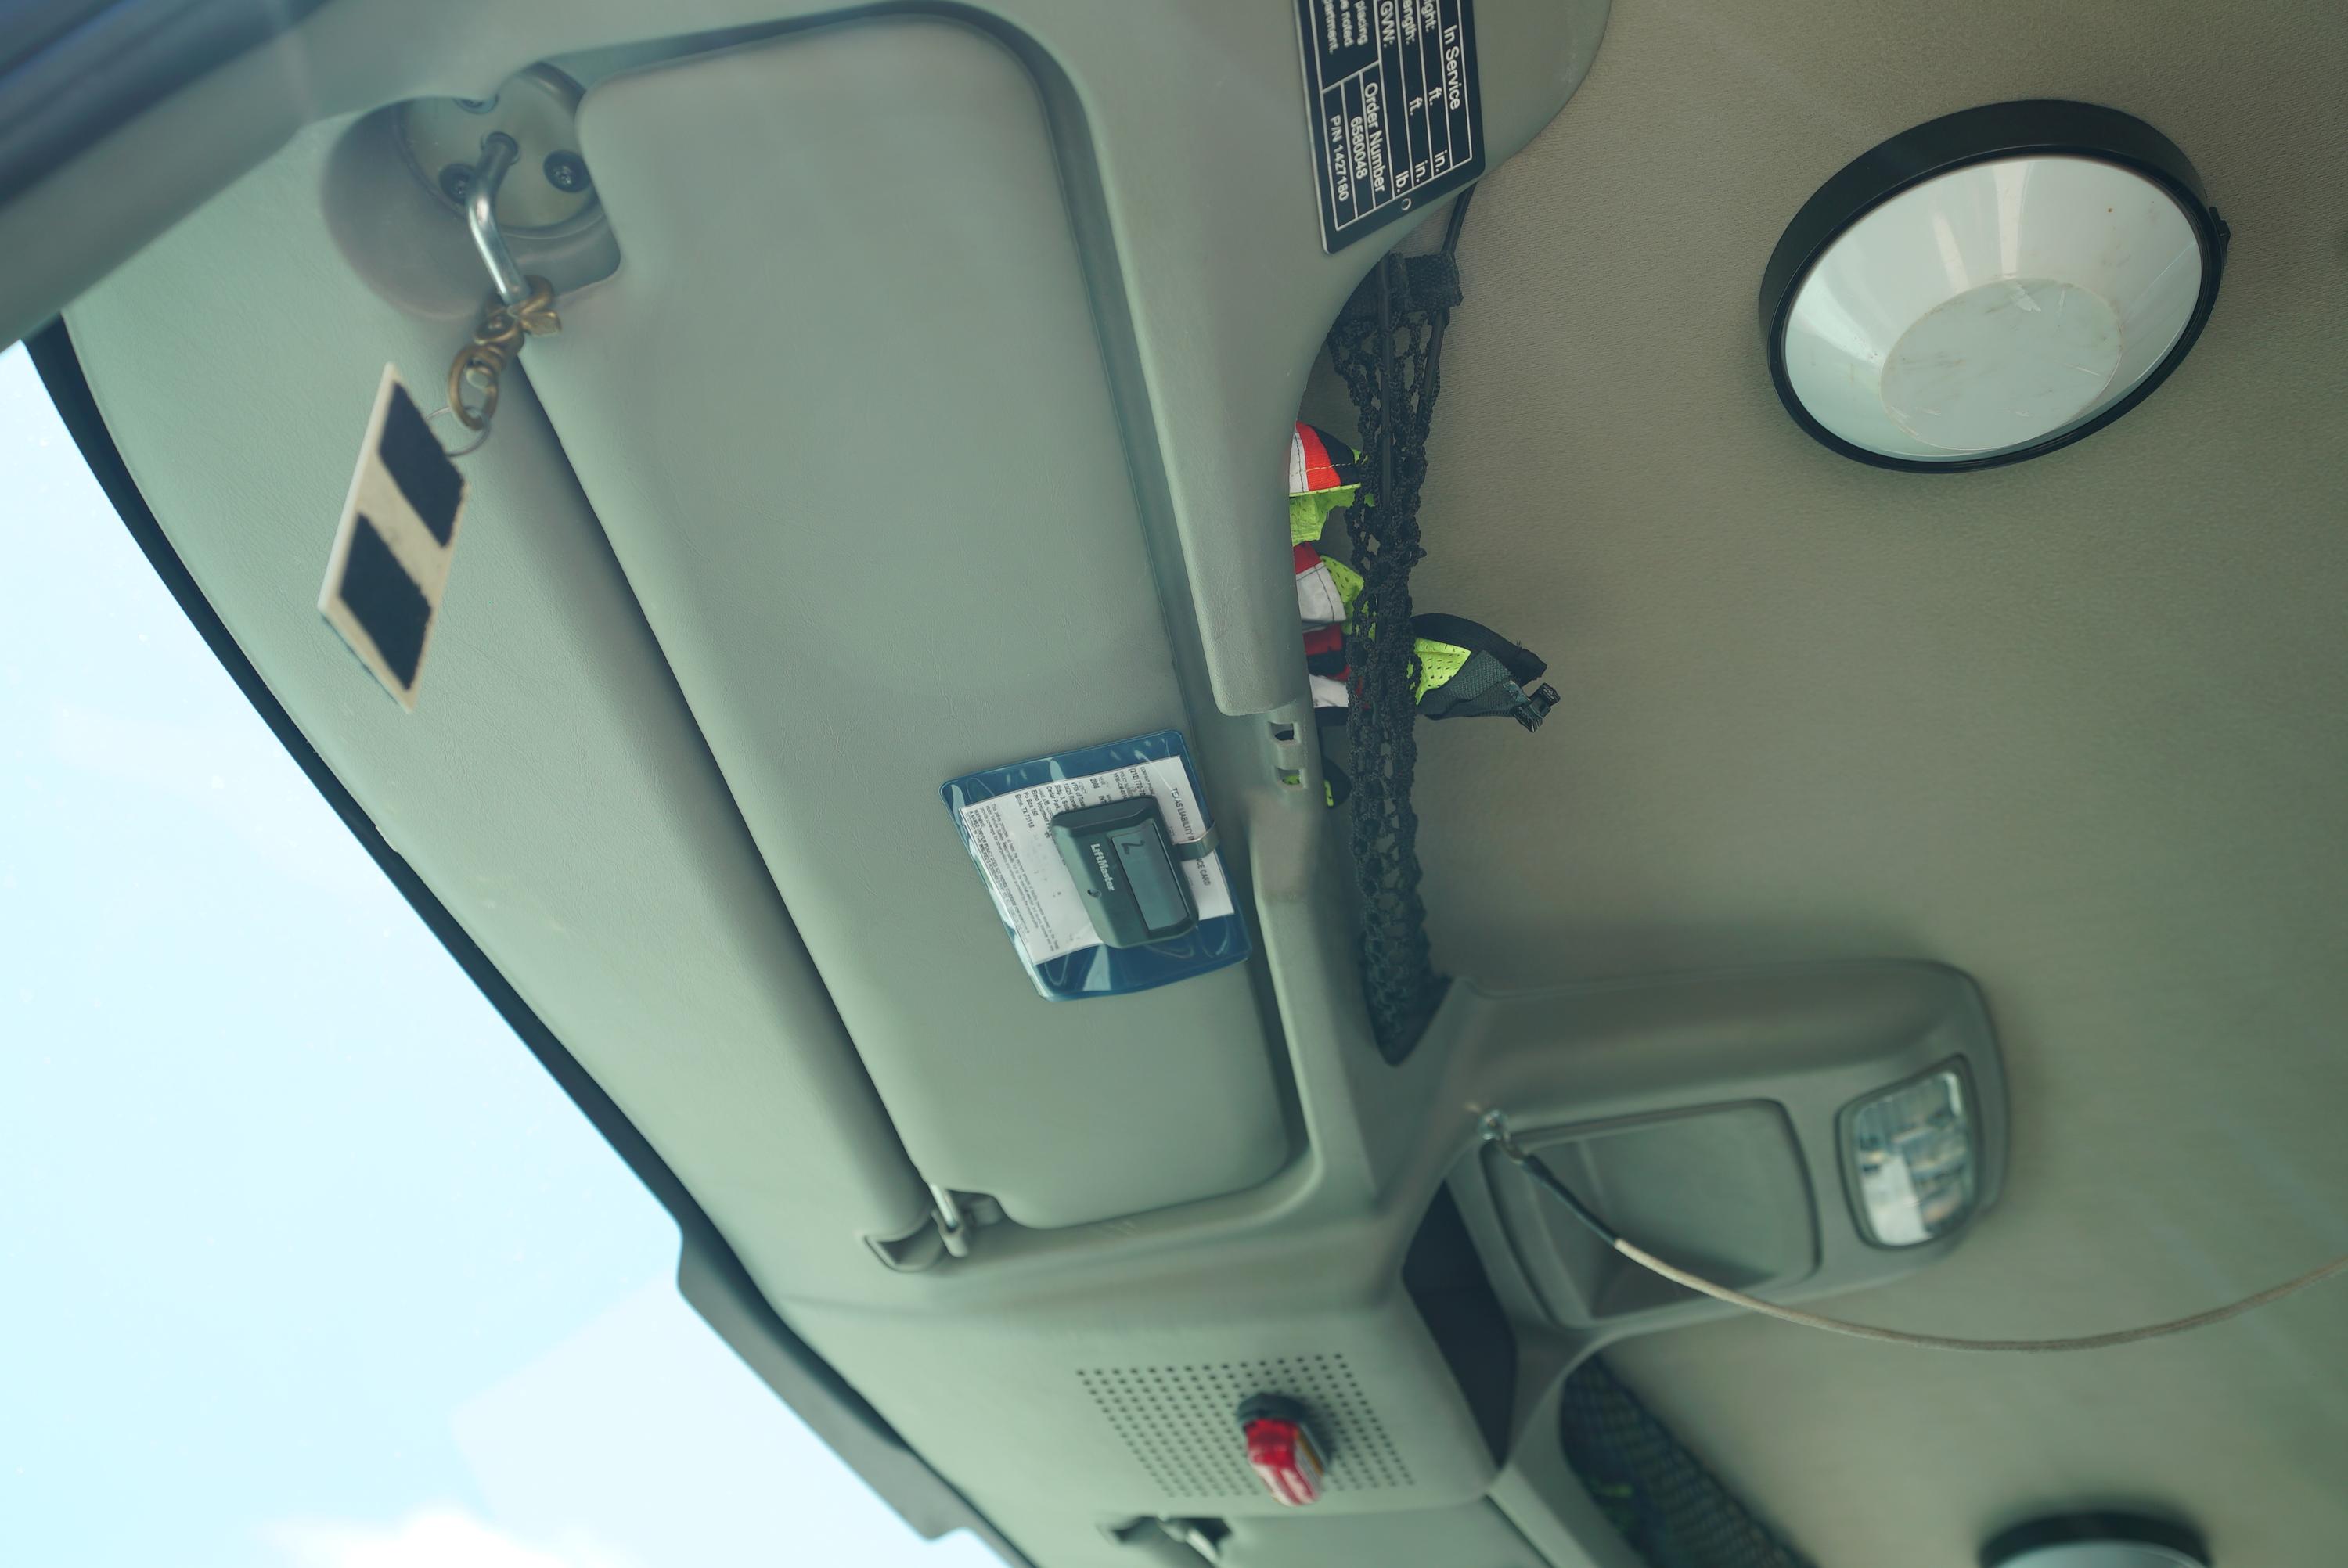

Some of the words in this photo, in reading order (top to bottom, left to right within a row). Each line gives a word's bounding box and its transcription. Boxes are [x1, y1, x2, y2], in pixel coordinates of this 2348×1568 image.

[1341, 11, 1354, 47] noted
[1354, 0, 1368, 45] placing
[1402, 0, 1417, 45] ength:
[1421, 0, 1437, 33] ight:
[1443, 24, 1457, 45] In
[1380, 0, 1396, 48] GVW:
[1395, 170, 1410, 193] lb.
[1428, 86, 1442, 106] ft.
[1446, 45, 1462, 110] Service
[1364, 81, 1380, 128] Order
[1409, 96, 1423, 117] ft.
[1331, 115, 1343, 143] P/N
[1350, 115, 1368, 180] 6580048
[1333, 143, 1349, 202] 1427180
[1369, 129, 1385, 192] Number
[1415, 160, 1428, 183] in.
[1435, 149, 1448, 173] in.
[1128, 768, 1140, 780] (212)
[1169, 787, 1183, 807] TEXAS
[1176, 807, 1193, 835] LIABILITY
[1198, 869, 1211, 886] CARD
[1090, 843, 1115, 891] LiftMaster
